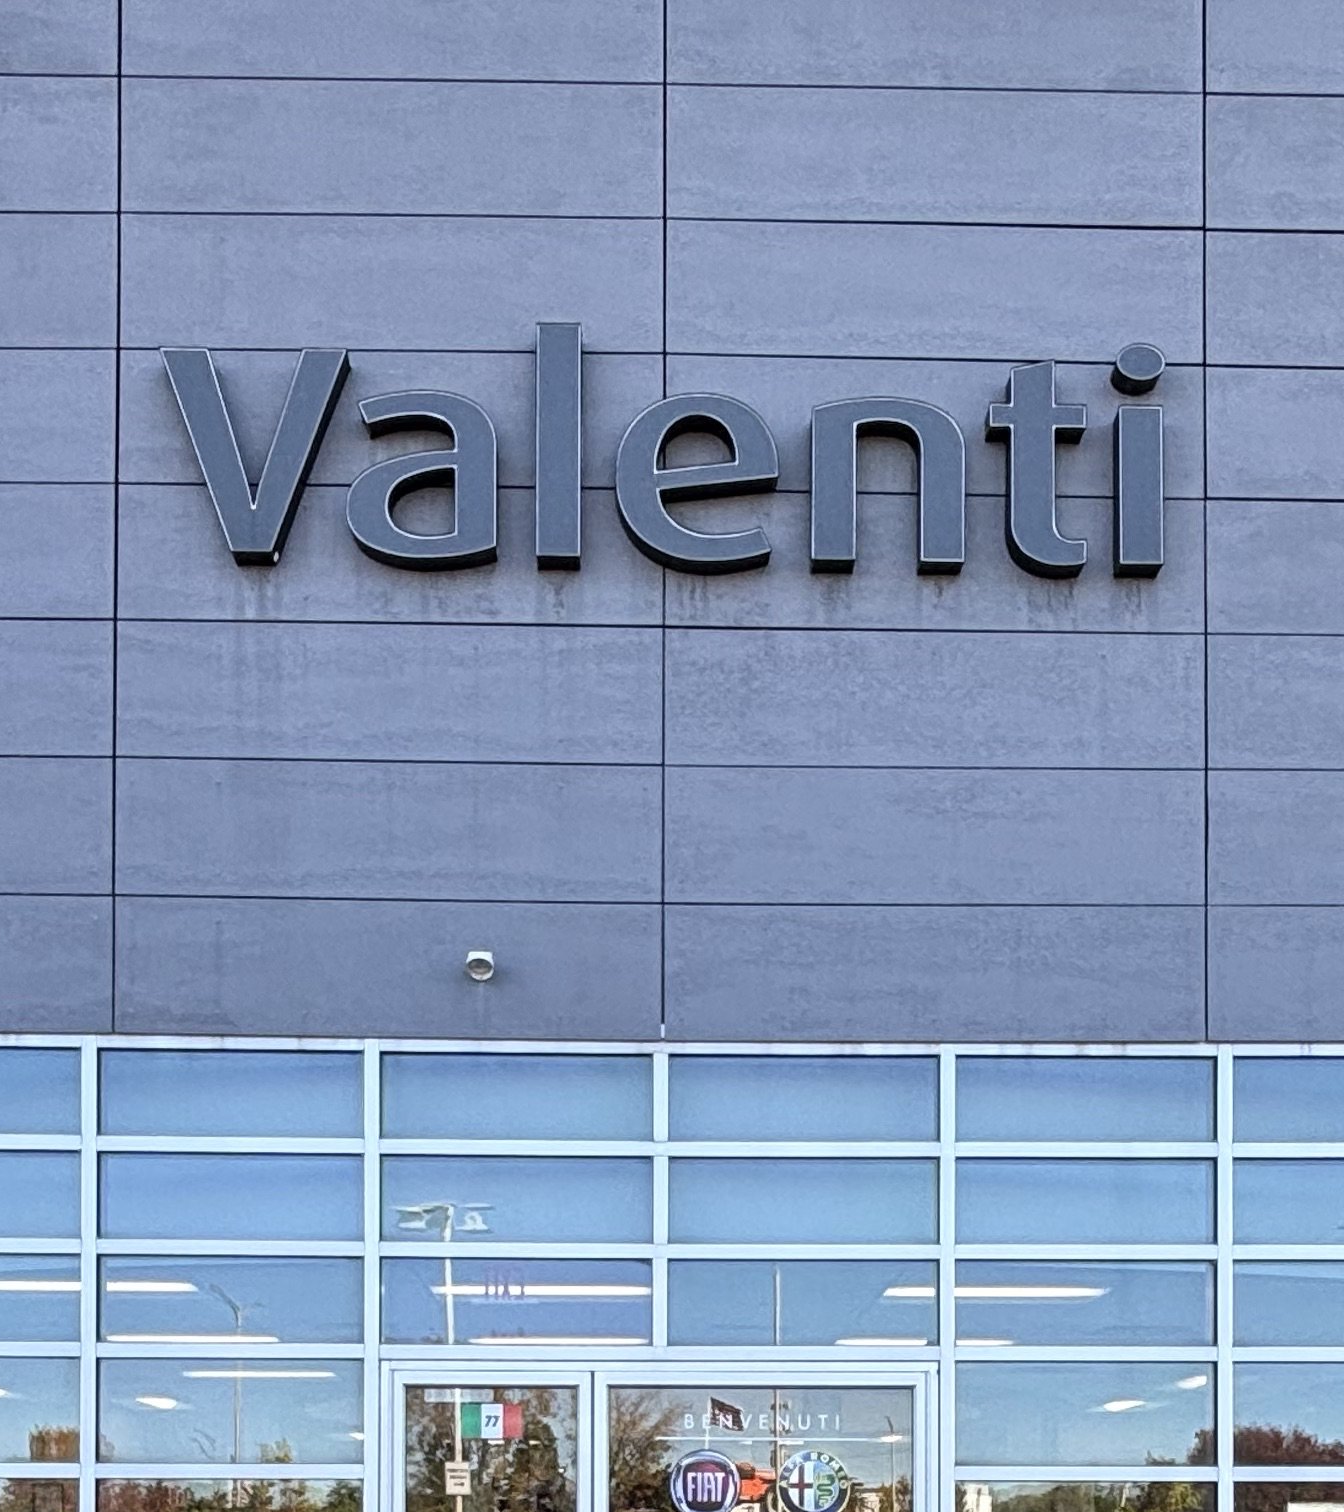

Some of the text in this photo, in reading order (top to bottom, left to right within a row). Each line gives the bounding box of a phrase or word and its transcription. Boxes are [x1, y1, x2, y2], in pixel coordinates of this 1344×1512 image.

[159, 320, 1167, 579] Valenti
[683, 1413, 841, 1431] BENVENUTI
[687, 1471, 726, 1503] FIAT
